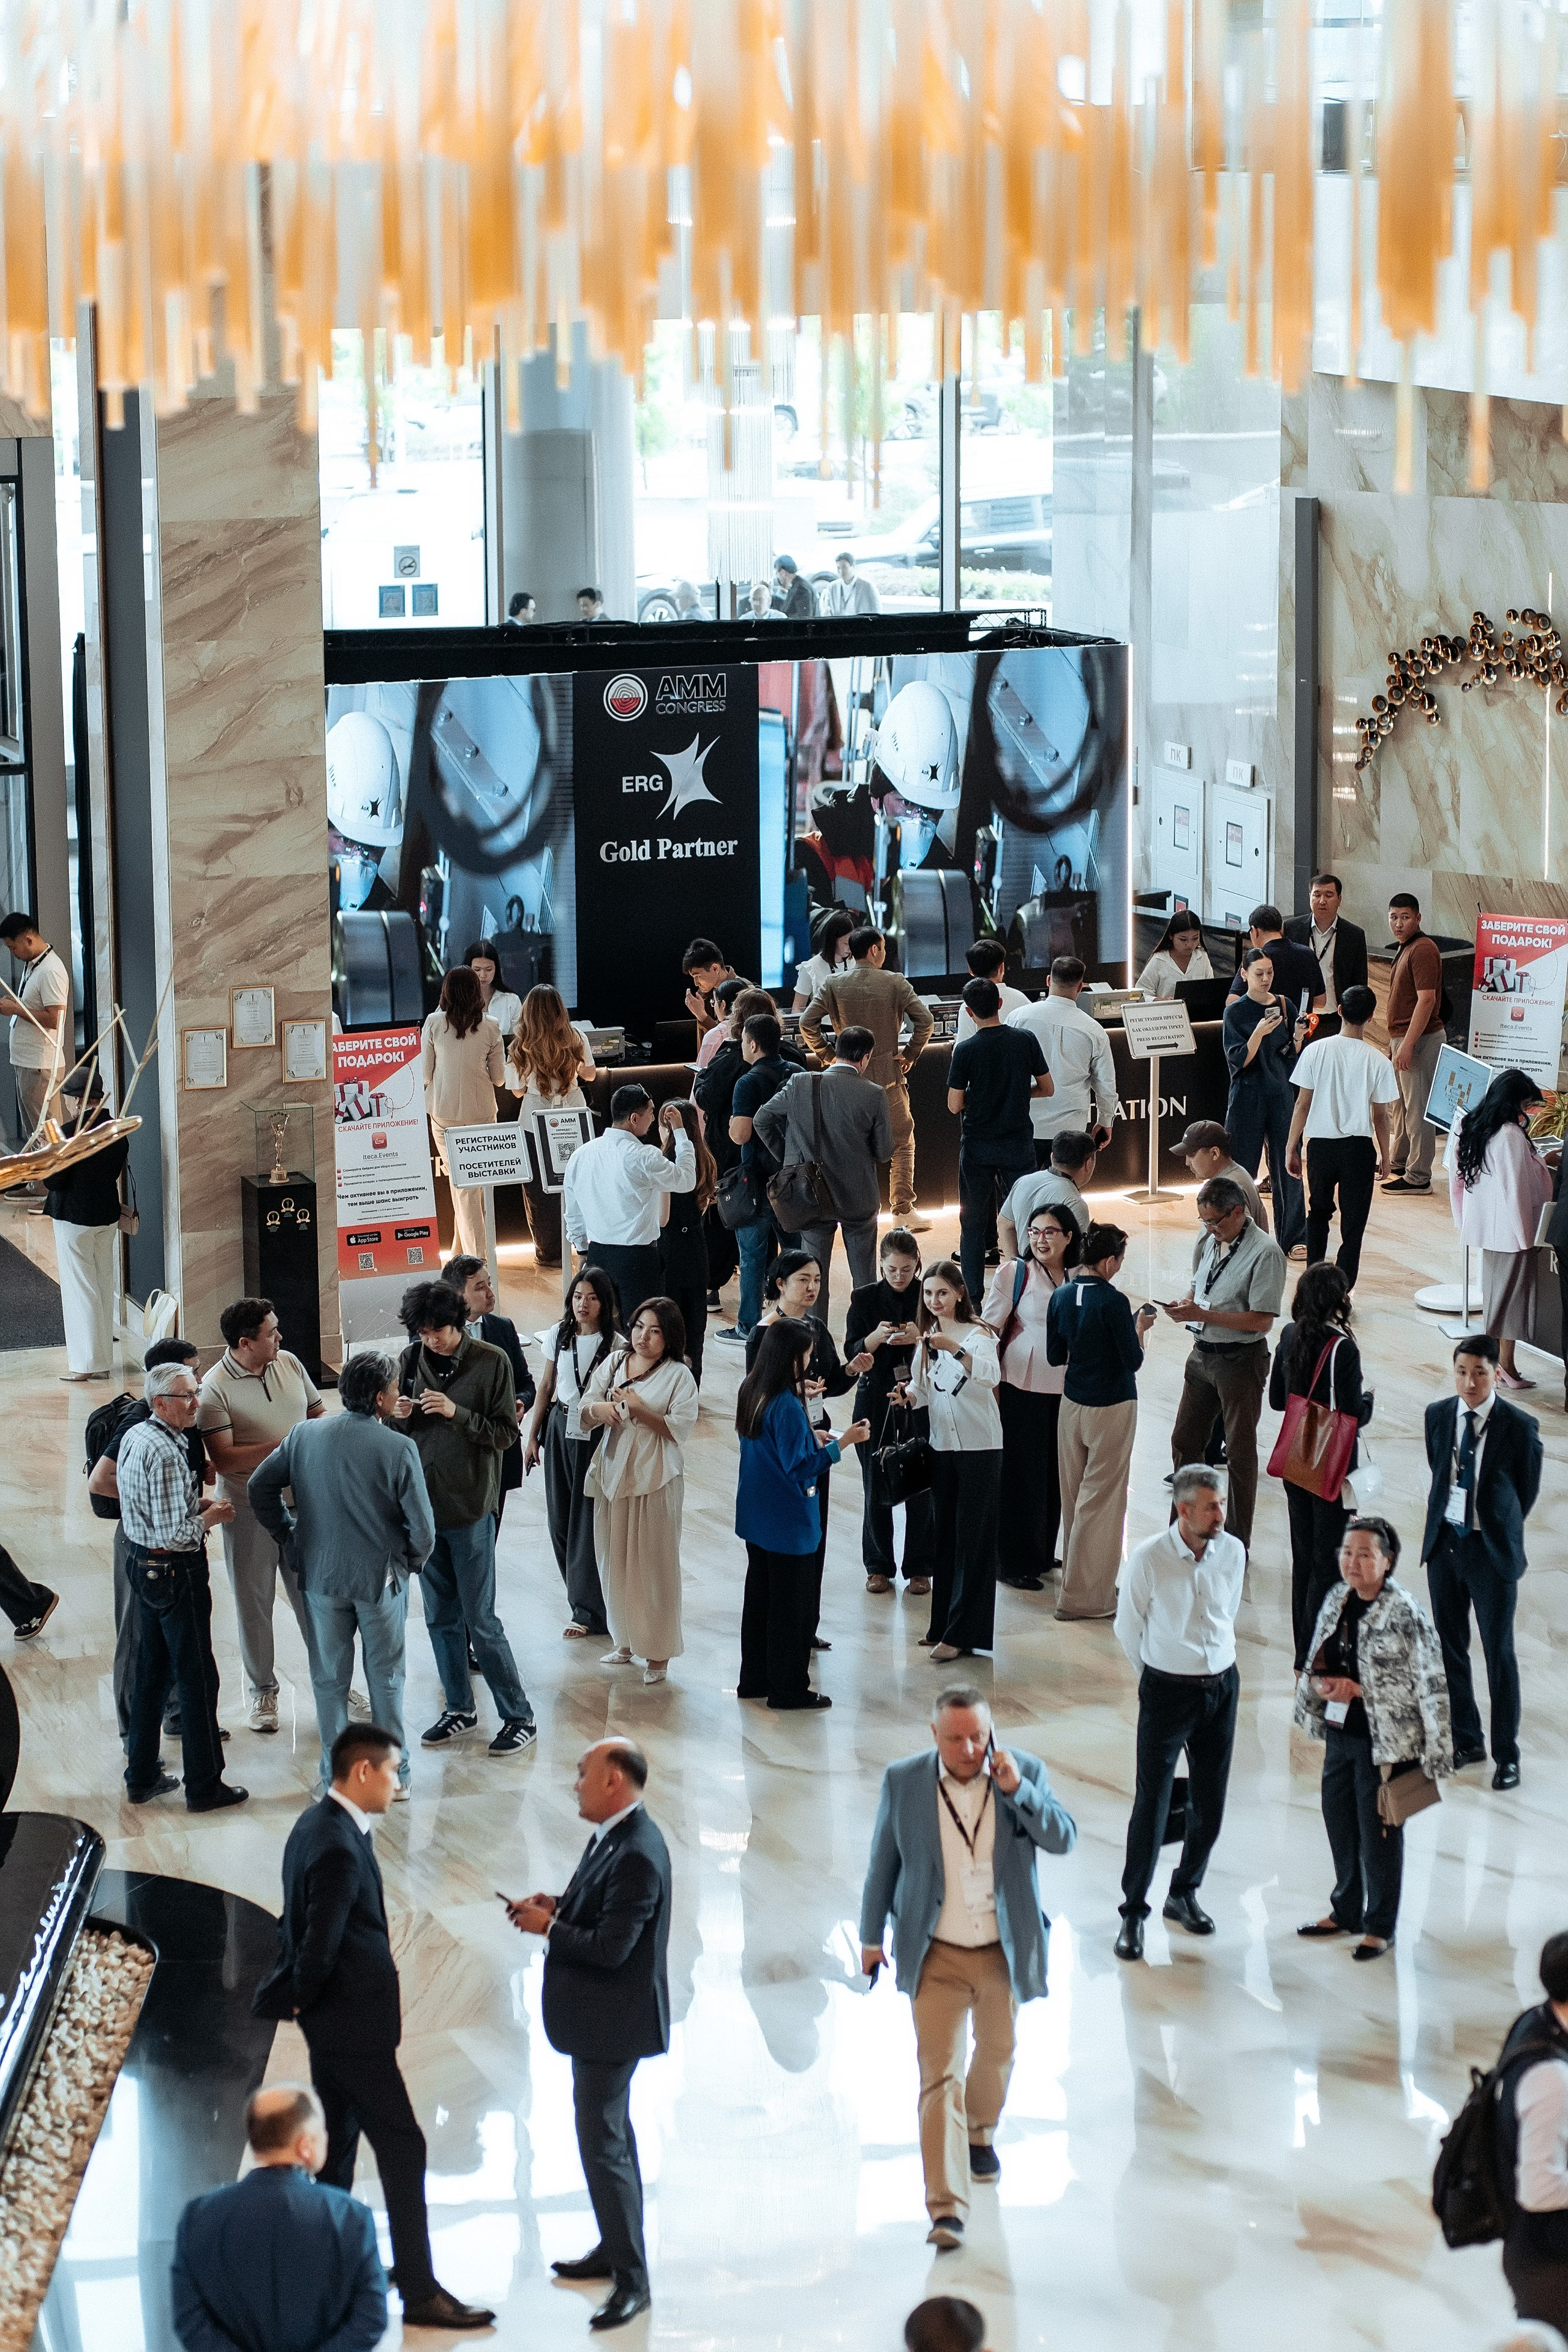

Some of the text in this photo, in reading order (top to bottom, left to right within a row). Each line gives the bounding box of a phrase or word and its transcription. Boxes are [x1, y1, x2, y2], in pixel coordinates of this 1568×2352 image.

[655, 673, 726, 700] AMM
[655, 700, 726, 715] CONGRESS
[1170, 748, 1182, 762] ПК
[622, 774, 663, 793] ERG
[600, 837, 738, 862] Gold Partner
[1481, 920, 1566, 936] ЗАБЕРИТЕ СВОЙ
[1491, 934, 1553, 949] ПОДАРОК!
[1513, 997, 1555, 1006] ПРИЛОЖЕНИЕ!
[333, 1033, 417, 1052] АБЕРИТЕ СВОЙ
[338, 1051, 405, 1068] ПОДАРОК!
[338, 1119, 418, 1133] СКАЧАЙТЕ ПРИЛОЖЕНИЕ!
[455, 1134, 517, 1145] РЕГИСТРАЦИЯ
[458, 1142, 517, 1153] УЧАСТНИКОВ
[363, 1152, 399, 1160] Iteca.Events
[459, 1157, 522, 1170] ПОСЕТИТЕЛЕЙ
[468, 1168, 516, 1178] ВЫСТАВКИ
[390, 1186, 428, 1195] приложении,
